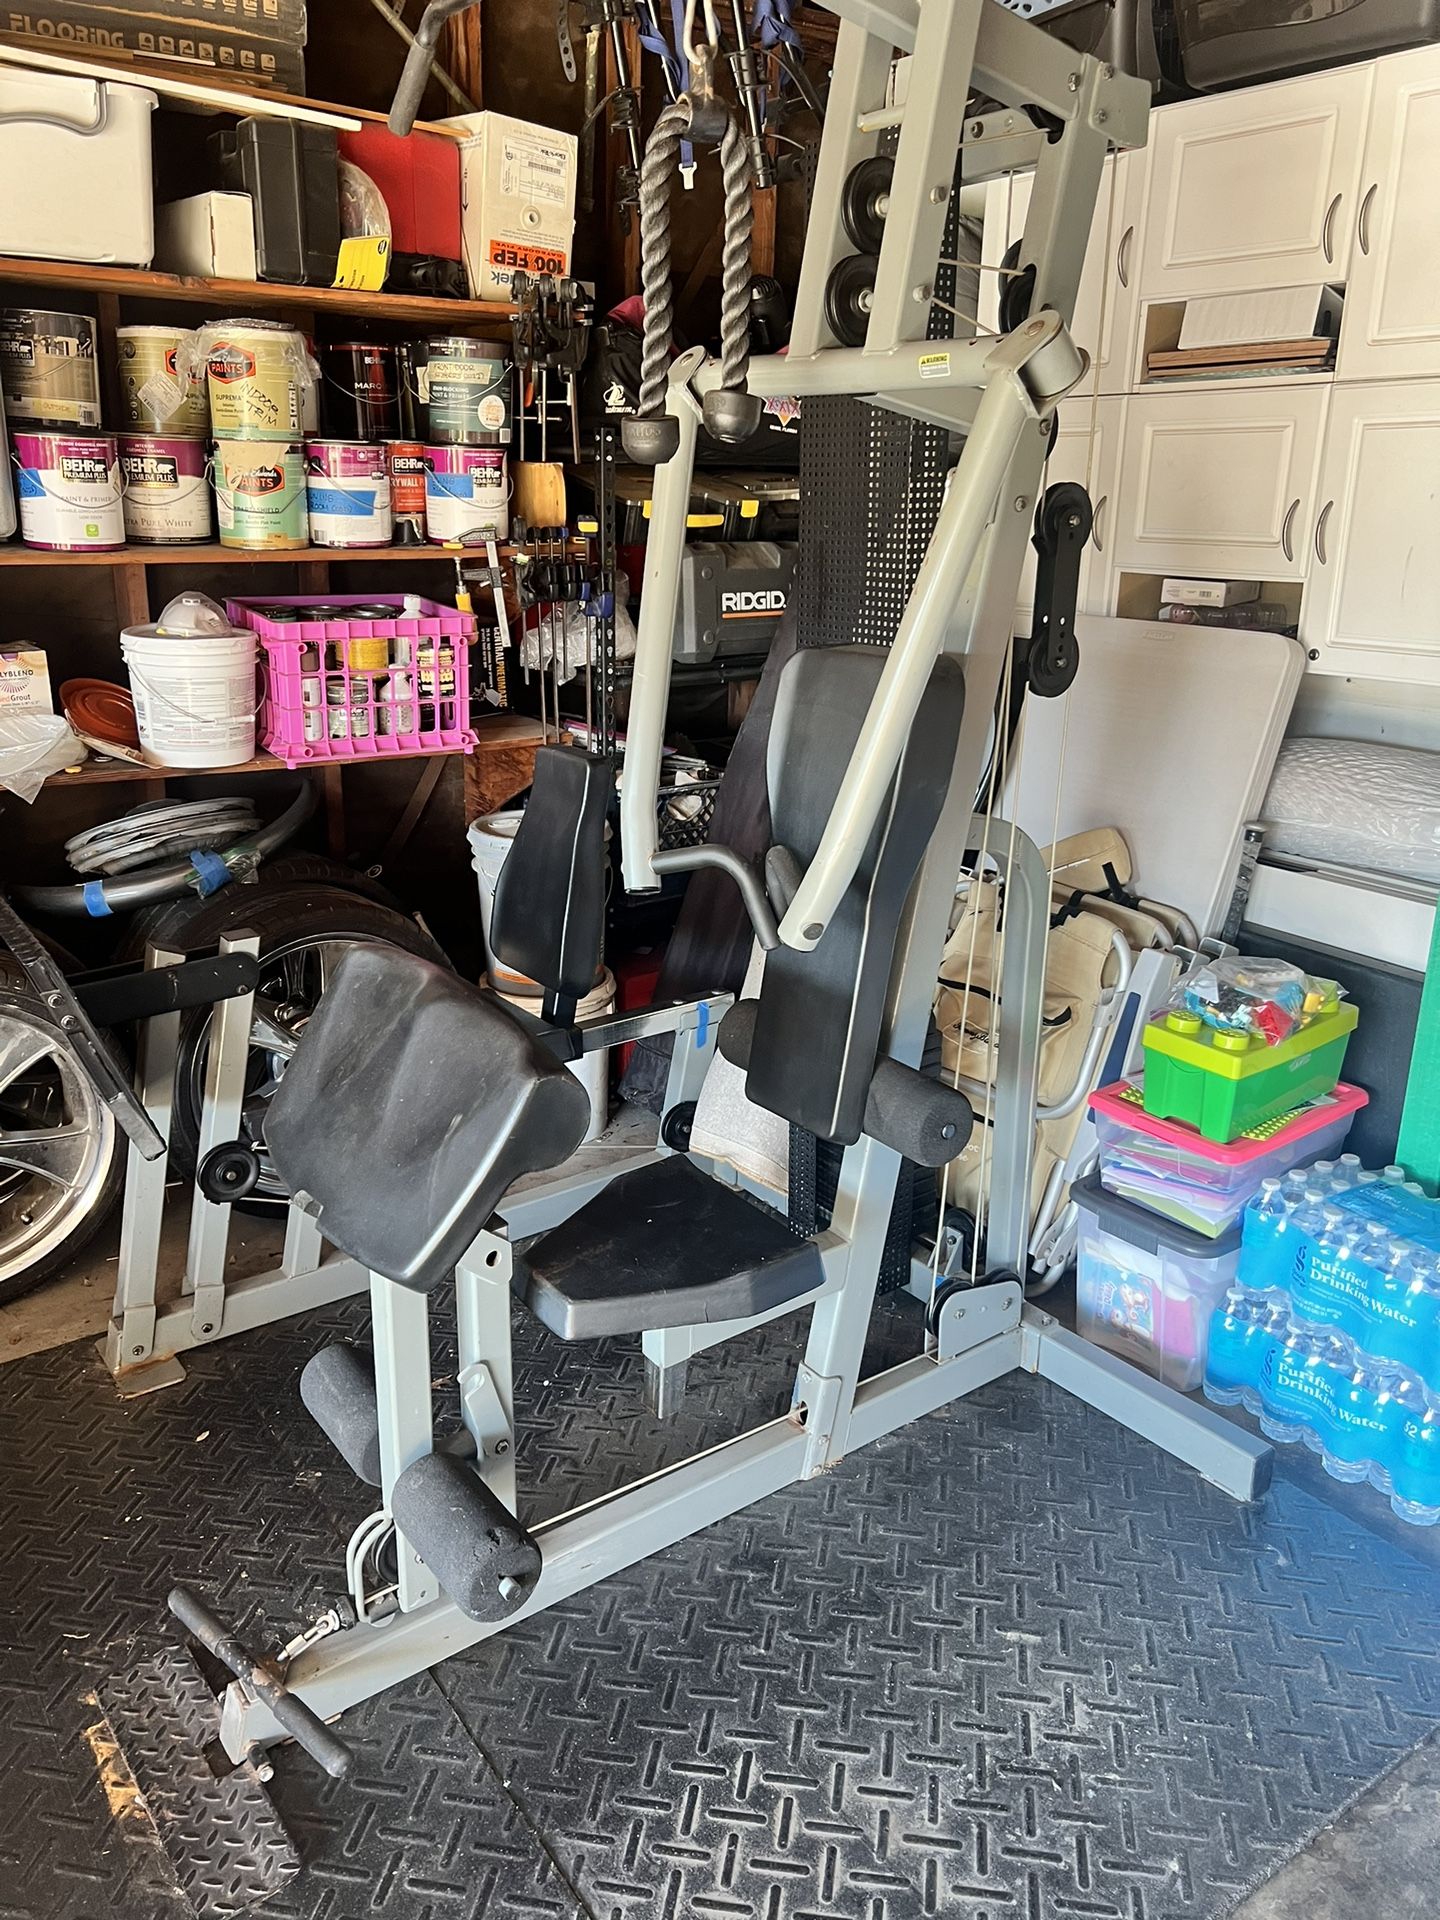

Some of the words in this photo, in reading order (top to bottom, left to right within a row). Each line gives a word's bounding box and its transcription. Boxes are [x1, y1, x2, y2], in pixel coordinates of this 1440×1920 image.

[211, 363, 243, 374] PAINTS
[240, 381, 279, 416] INDOOR
[246, 400, 277, 427] TRIM
[63, 458, 94, 472] BEHR
[394, 458, 417, 470] BEHR
[156, 474, 175, 482] PLUS
[470, 467, 494, 478] BEHR
[241, 478, 274, 488] AINTS
[166, 519, 192, 527] WHITE
[0, 670, 34, 678] LYBLEND
[10, 694, 31, 702] Grout
[1311, 1256, 1369, 1290] Purified
[1309, 1268, 1370, 1307] Drinking
[1370, 1298, 1417, 1328] Water
[1277, 1374, 1337, 1417] Drinking
[1338, 1408, 1388, 1434] Water
